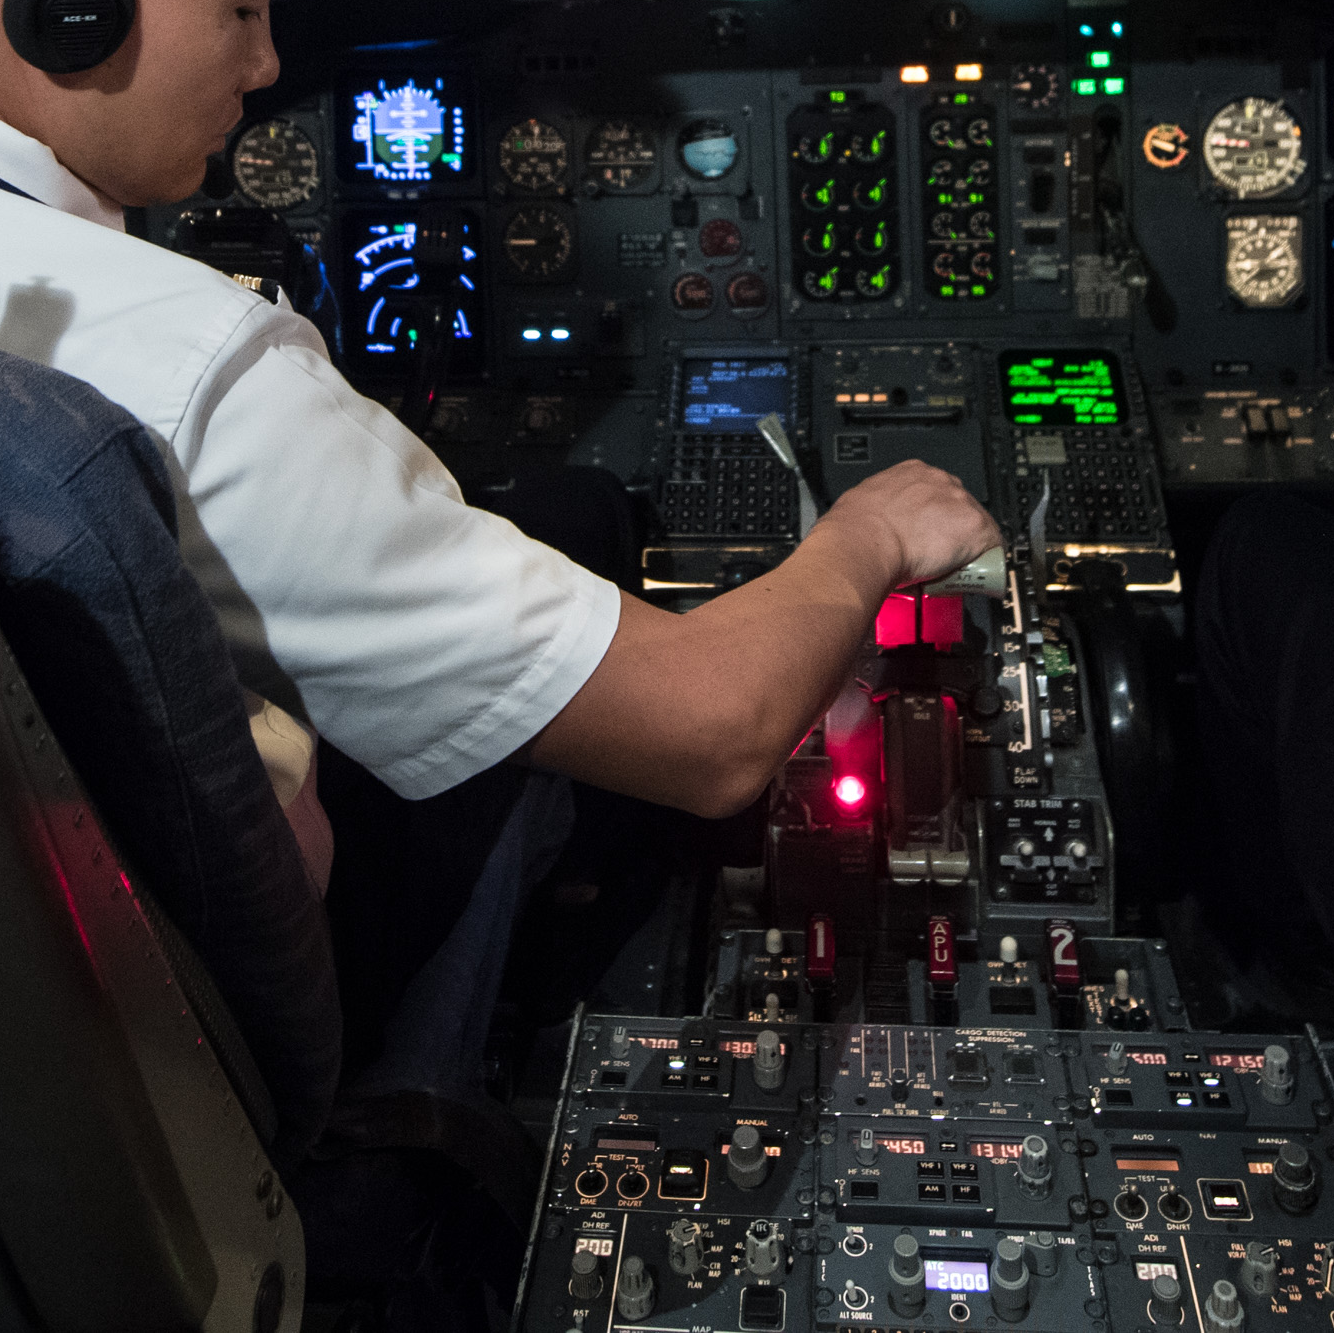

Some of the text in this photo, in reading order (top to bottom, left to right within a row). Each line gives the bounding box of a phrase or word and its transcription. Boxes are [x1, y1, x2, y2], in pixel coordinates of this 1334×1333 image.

[1001, 625, 1017, 636] 10
[1003, 643, 1015, 653] 15
[1002, 666, 1016, 677] 25
[1003, 701, 1018, 712] 30
[1007, 741, 1024, 753] 40
[1013, 767, 1038, 777] FLAP
[1013, 775, 1039, 785] DOWN
[1013, 799, 1063, 809] STAB TRIM
[813, 921, 825, 958] 1
[932, 923, 949, 964] APU
[1053, 927, 1078, 966] 2
[926, 1262, 944, 1271] ATC
[938, 1273, 988, 1291] 2000
[851, 1312, 873, 1320] SOURCE
